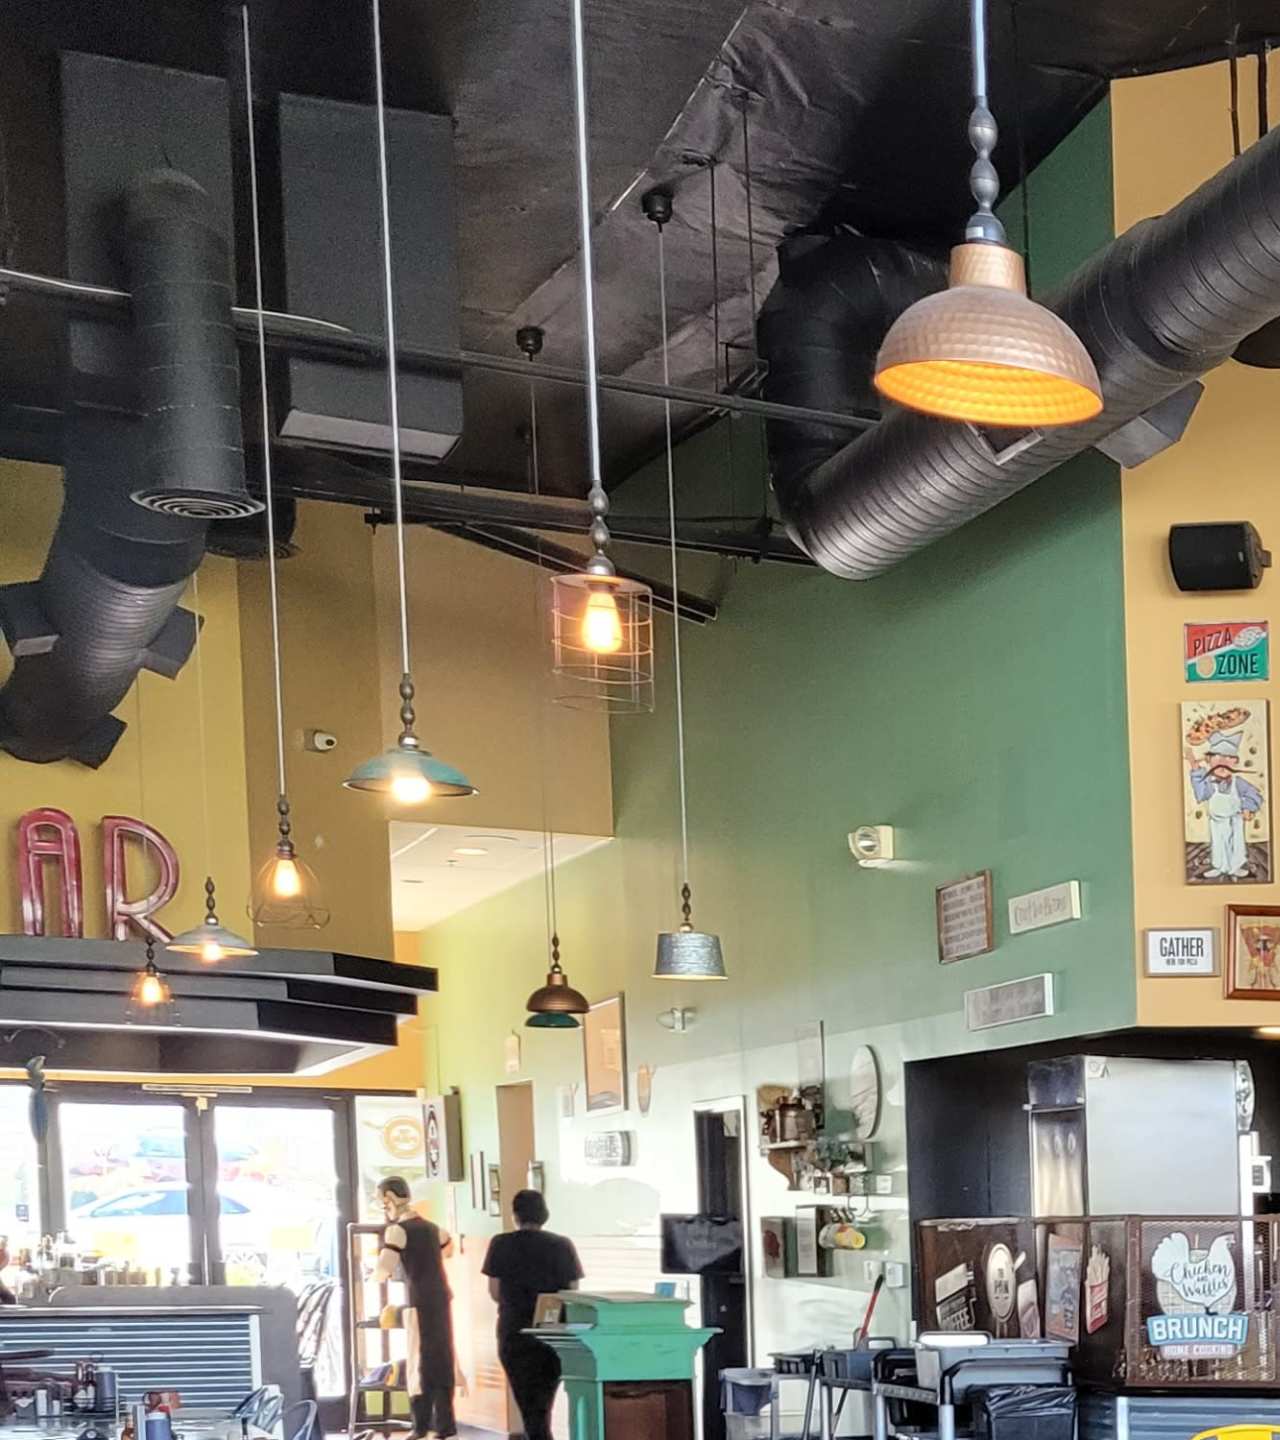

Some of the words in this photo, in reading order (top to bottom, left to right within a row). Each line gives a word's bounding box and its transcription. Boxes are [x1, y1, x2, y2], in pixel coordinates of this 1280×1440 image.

[1193, 627, 1233, 657] PIZZA
[1217, 653, 1259, 675] ZONE
[18, 807, 181, 943] AR
[1160, 937, 1204, 958] GATHER
[1171, 1260, 1231, 1285] Chicken
[1183, 1278, 1228, 1298] Waffles
[1152, 1316, 1243, 1340] BRUNCH
